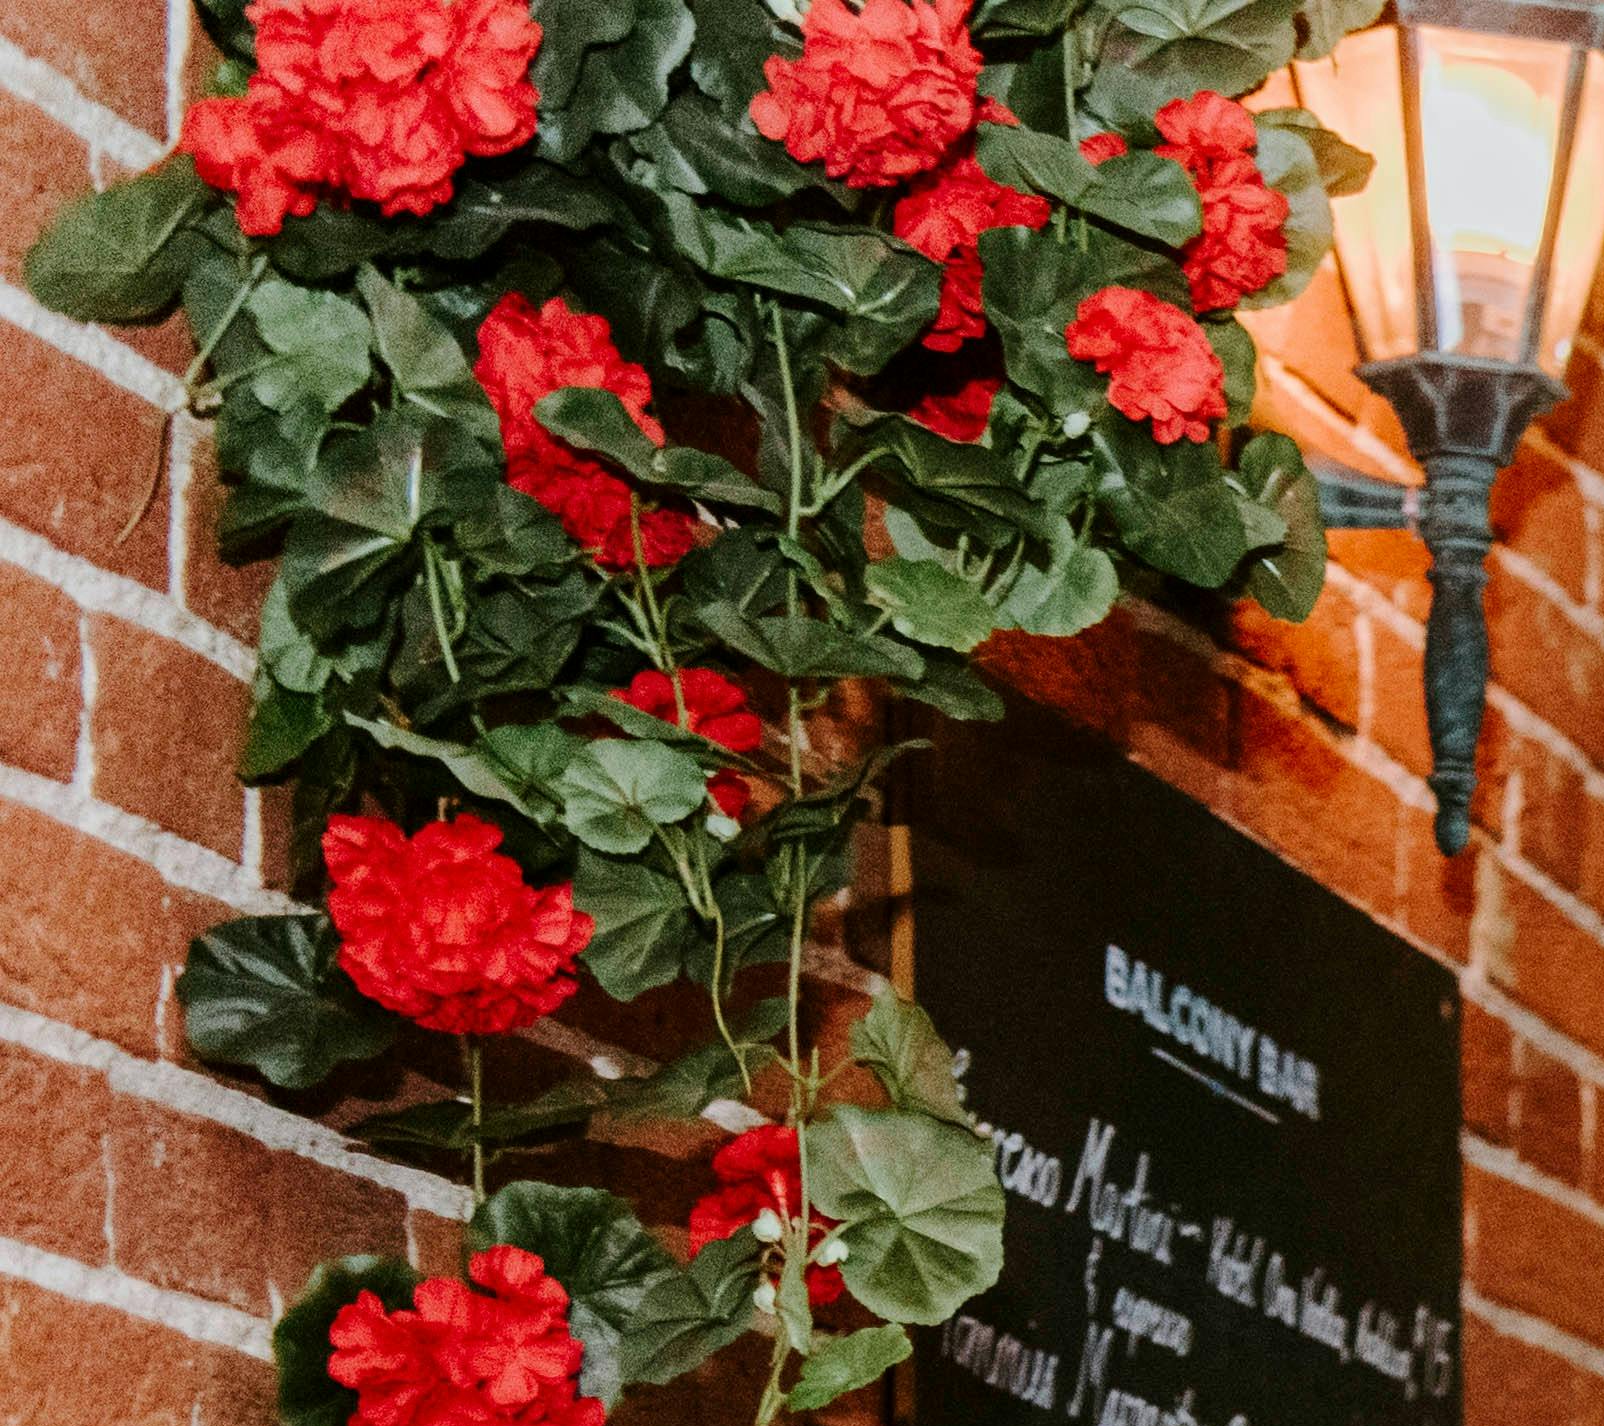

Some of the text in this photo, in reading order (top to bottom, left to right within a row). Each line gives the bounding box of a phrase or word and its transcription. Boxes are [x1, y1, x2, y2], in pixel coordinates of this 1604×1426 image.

[1104, 944, 1320, 1119] BALCONY BAR
[1064, 1117, 1174, 1265] Martini
